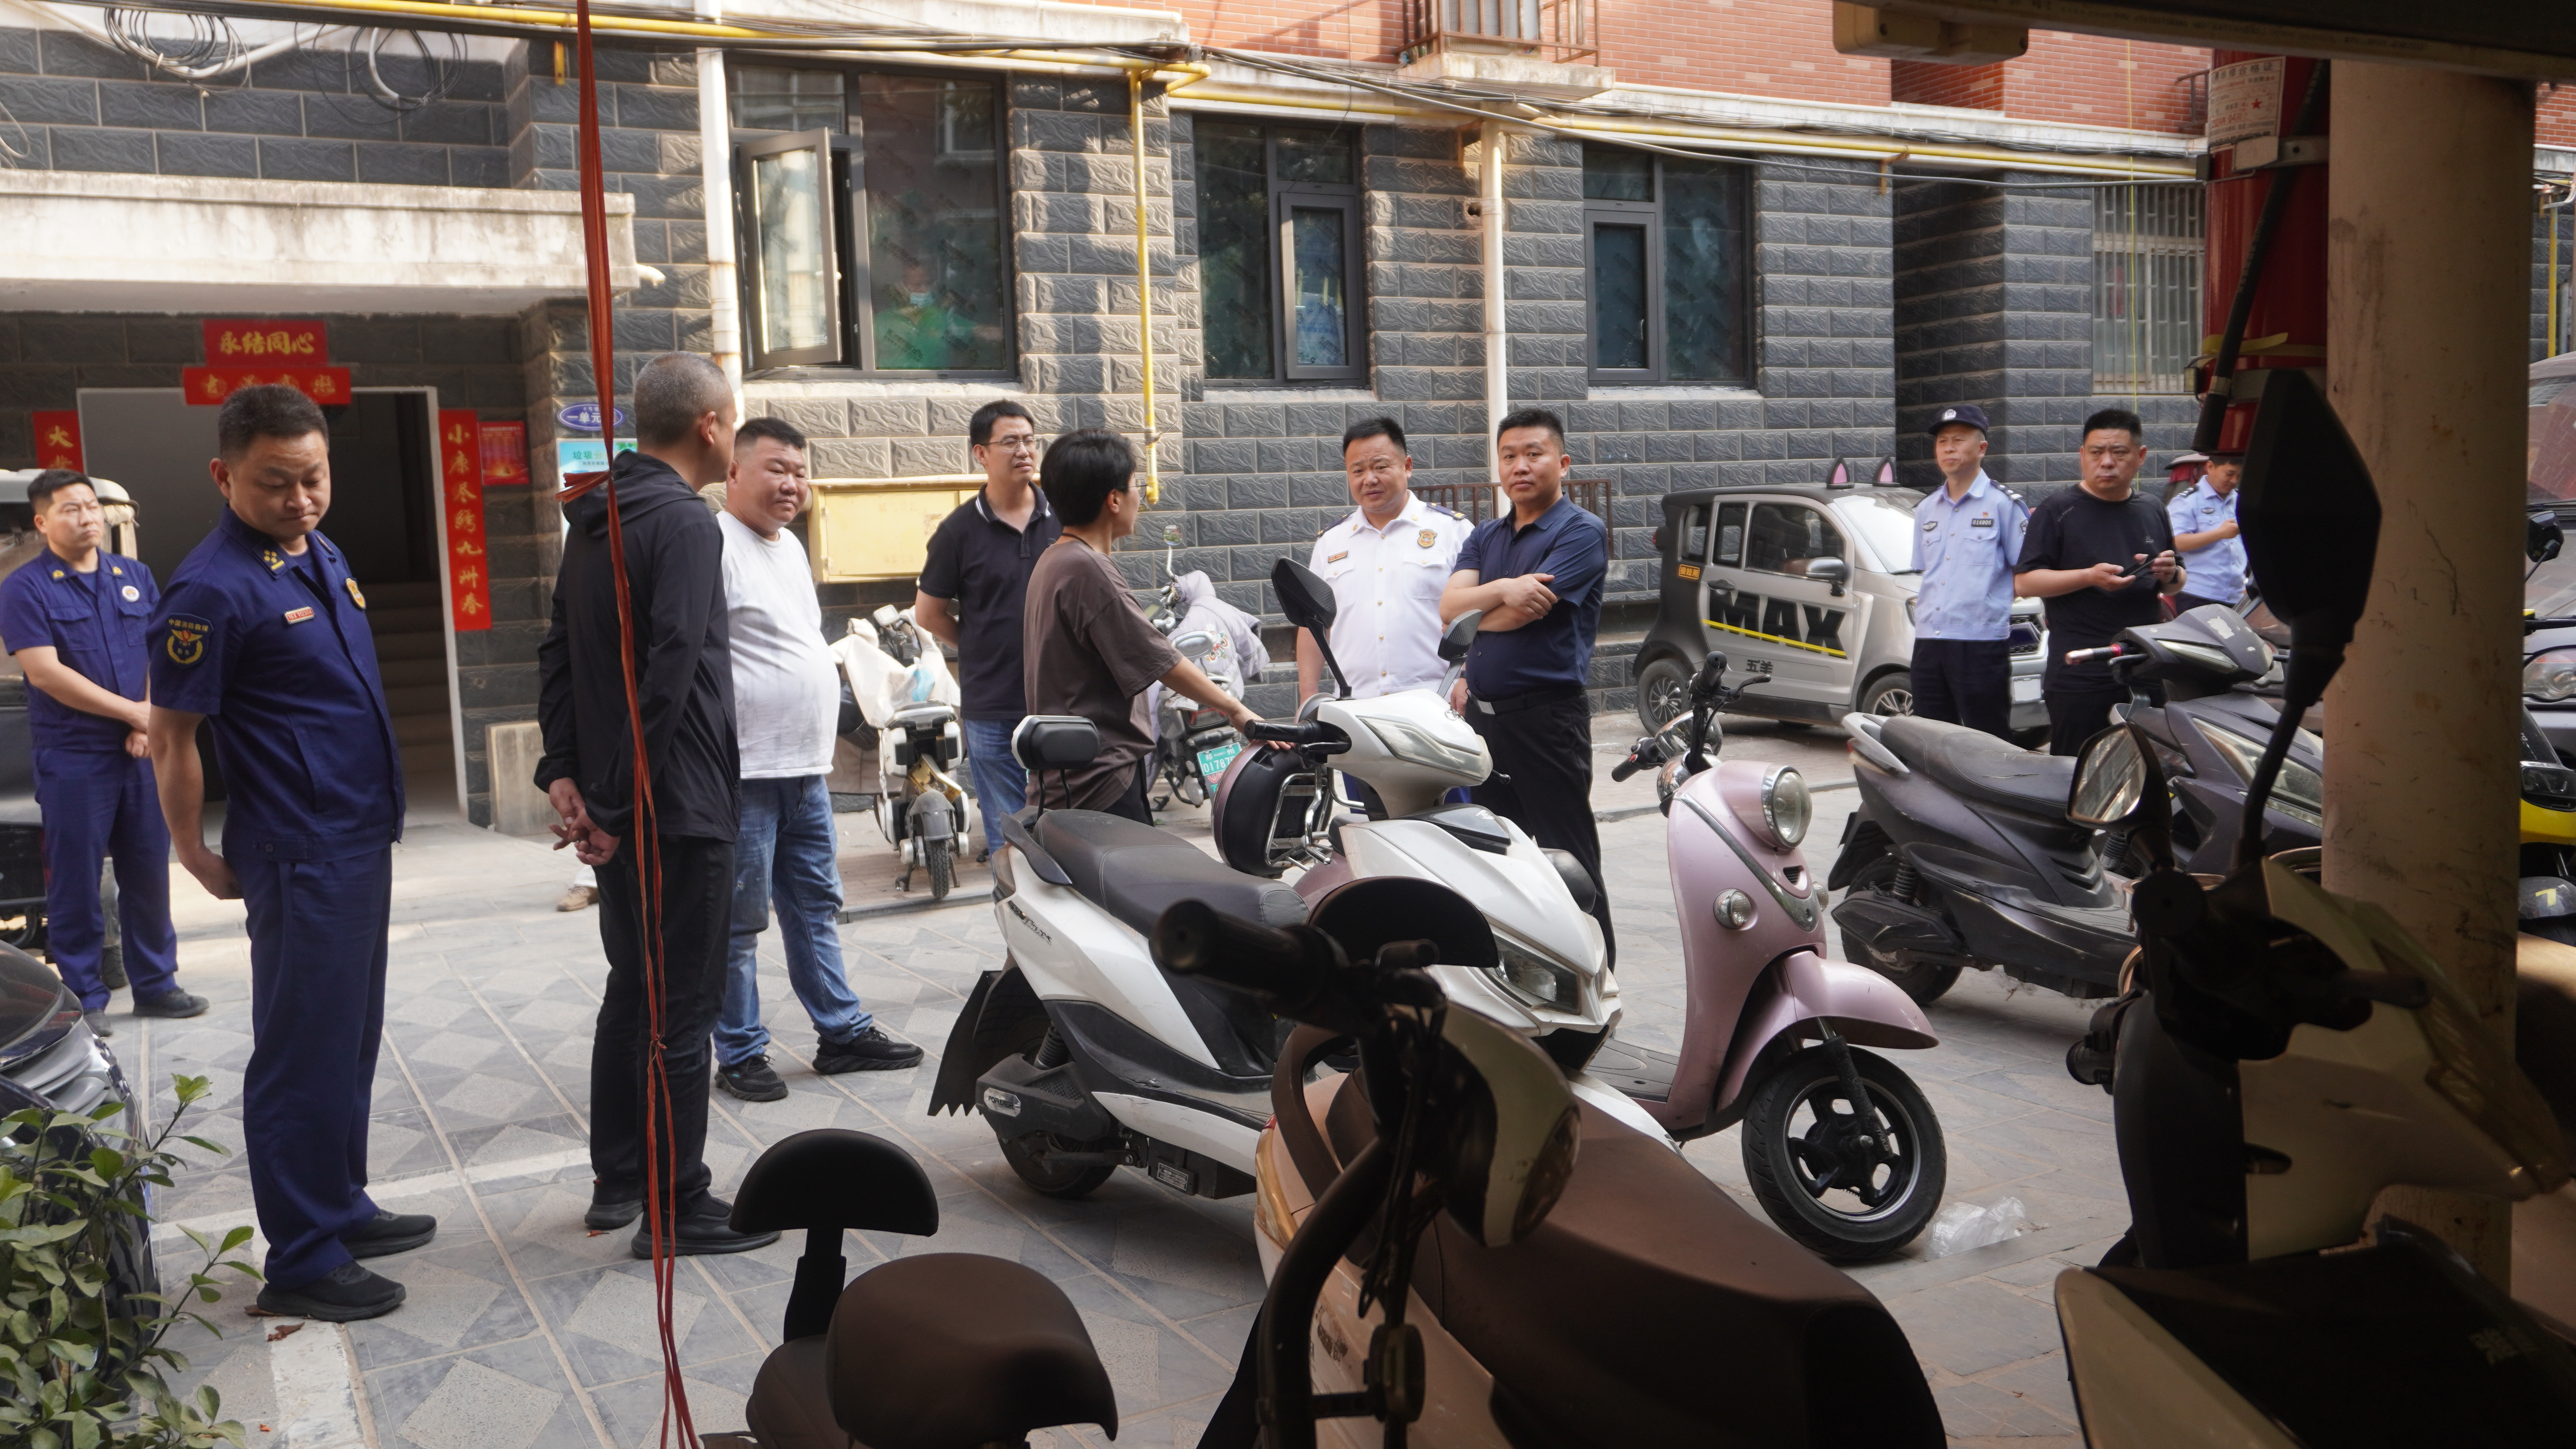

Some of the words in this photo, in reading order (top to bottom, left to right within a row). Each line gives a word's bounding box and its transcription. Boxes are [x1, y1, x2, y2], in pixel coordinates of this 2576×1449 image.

[220, 330, 315, 355] 永结同心
[204, 373, 336, 394] 吉照
[567, 412, 616, 423] 一单元
[573, 451, 608, 459] 垃圾分
[1679, 566, 1698, 577] 接娃用
[1710, 589, 1847, 659] MAX
[1746, 659, 1774, 674] 五羊
